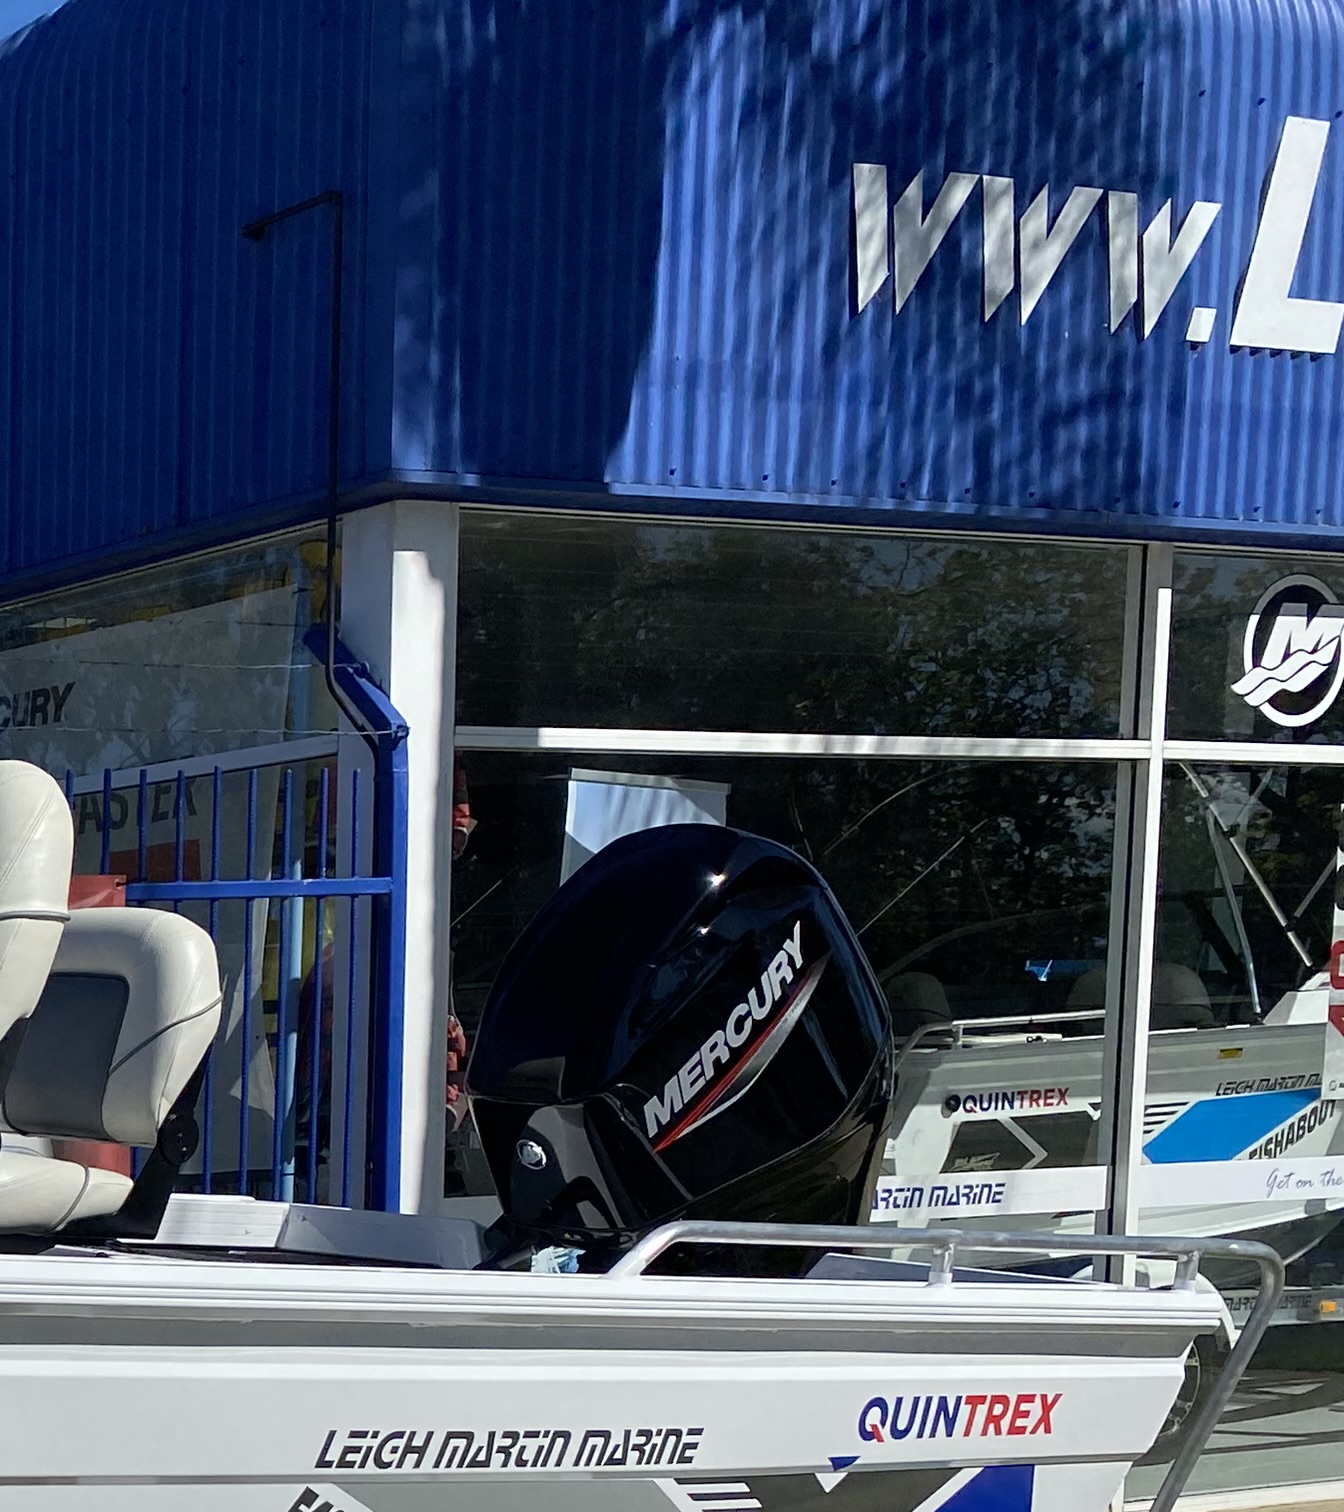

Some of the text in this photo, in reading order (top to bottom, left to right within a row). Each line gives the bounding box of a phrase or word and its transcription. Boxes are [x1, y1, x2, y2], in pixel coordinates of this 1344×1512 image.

[644, 920, 803, 1138] MERCURY
[962, 1087, 1070, 1114] QUINTREX
[872, 1182, 1007, 1211] ARTIN MARINE
[1266, 1167, 1296, 1199] Get
[1295, 1180, 1314, 1190] on
[858, 1392, 1064, 1443] QUINTREX
[314, 1427, 705, 1469] LEIGH MARTIN MARINE
